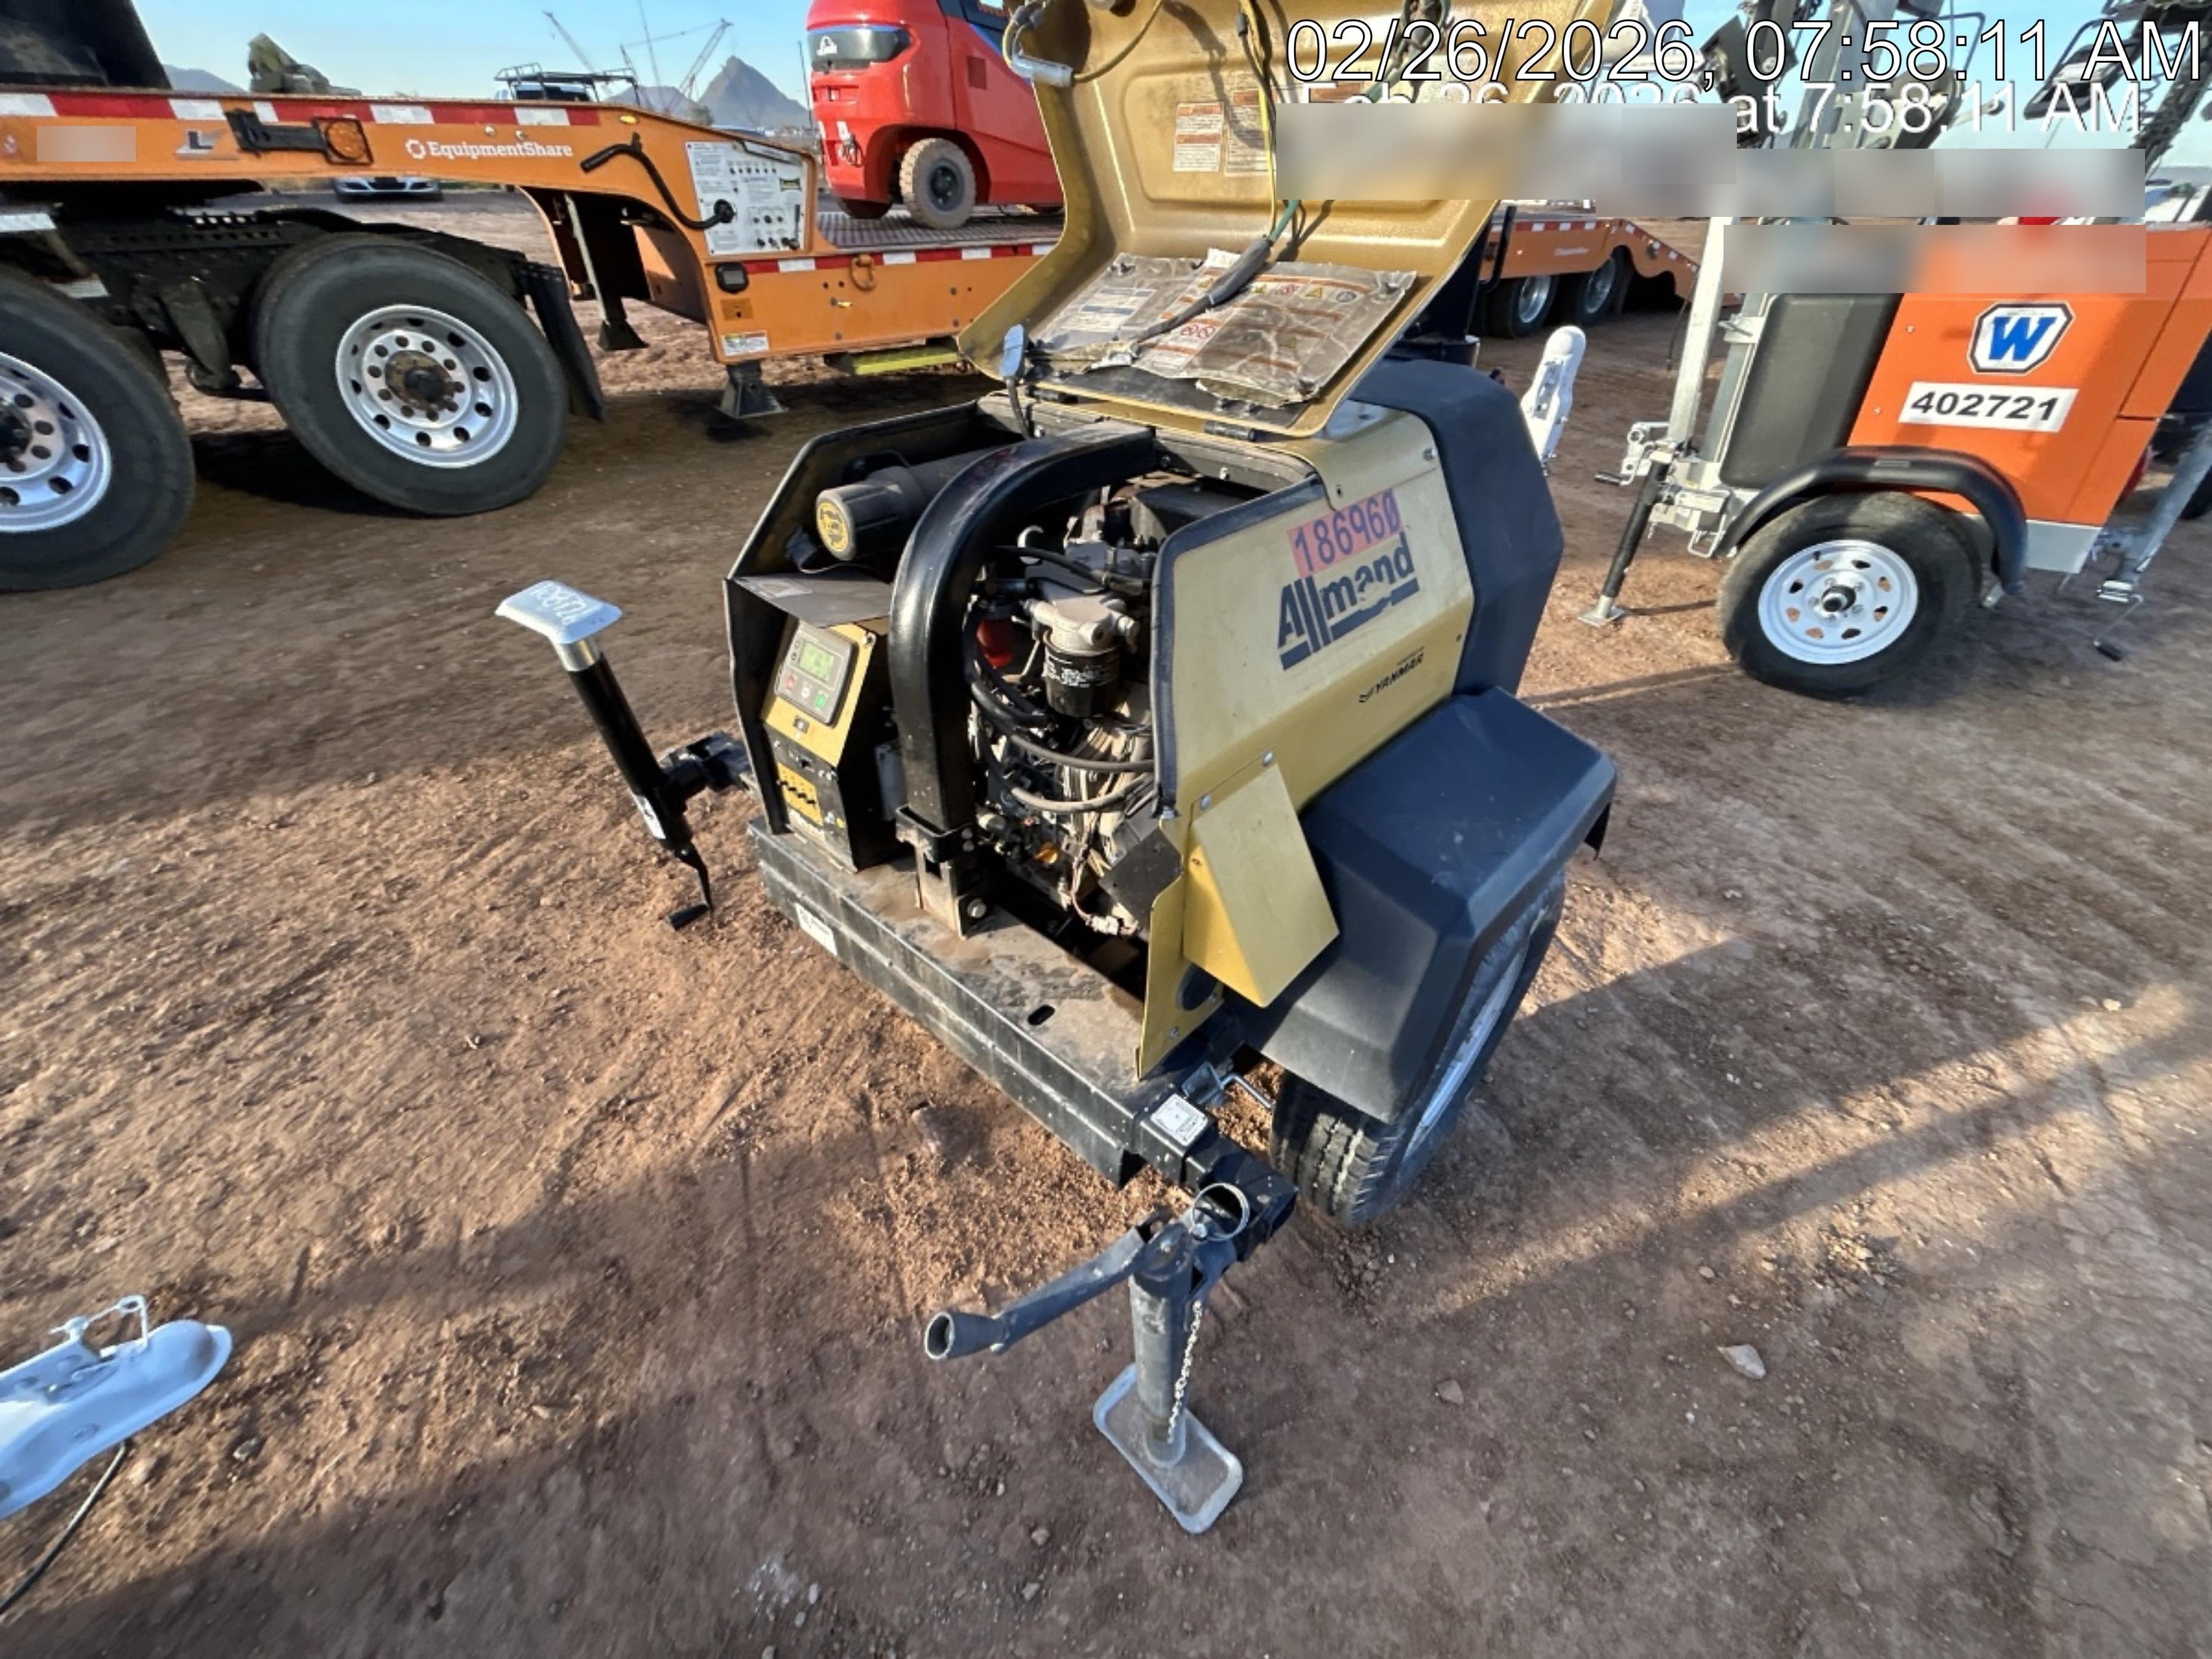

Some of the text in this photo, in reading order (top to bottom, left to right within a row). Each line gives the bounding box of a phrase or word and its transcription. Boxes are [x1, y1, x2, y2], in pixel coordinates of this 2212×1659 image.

[426, 141, 574, 160] EquipmentShare
[1989, 316, 2058, 361] W
[1910, 390, 2060, 422] 402721
[1294, 488, 1400, 573] 186960
[1277, 530, 1415, 654] Allmand
